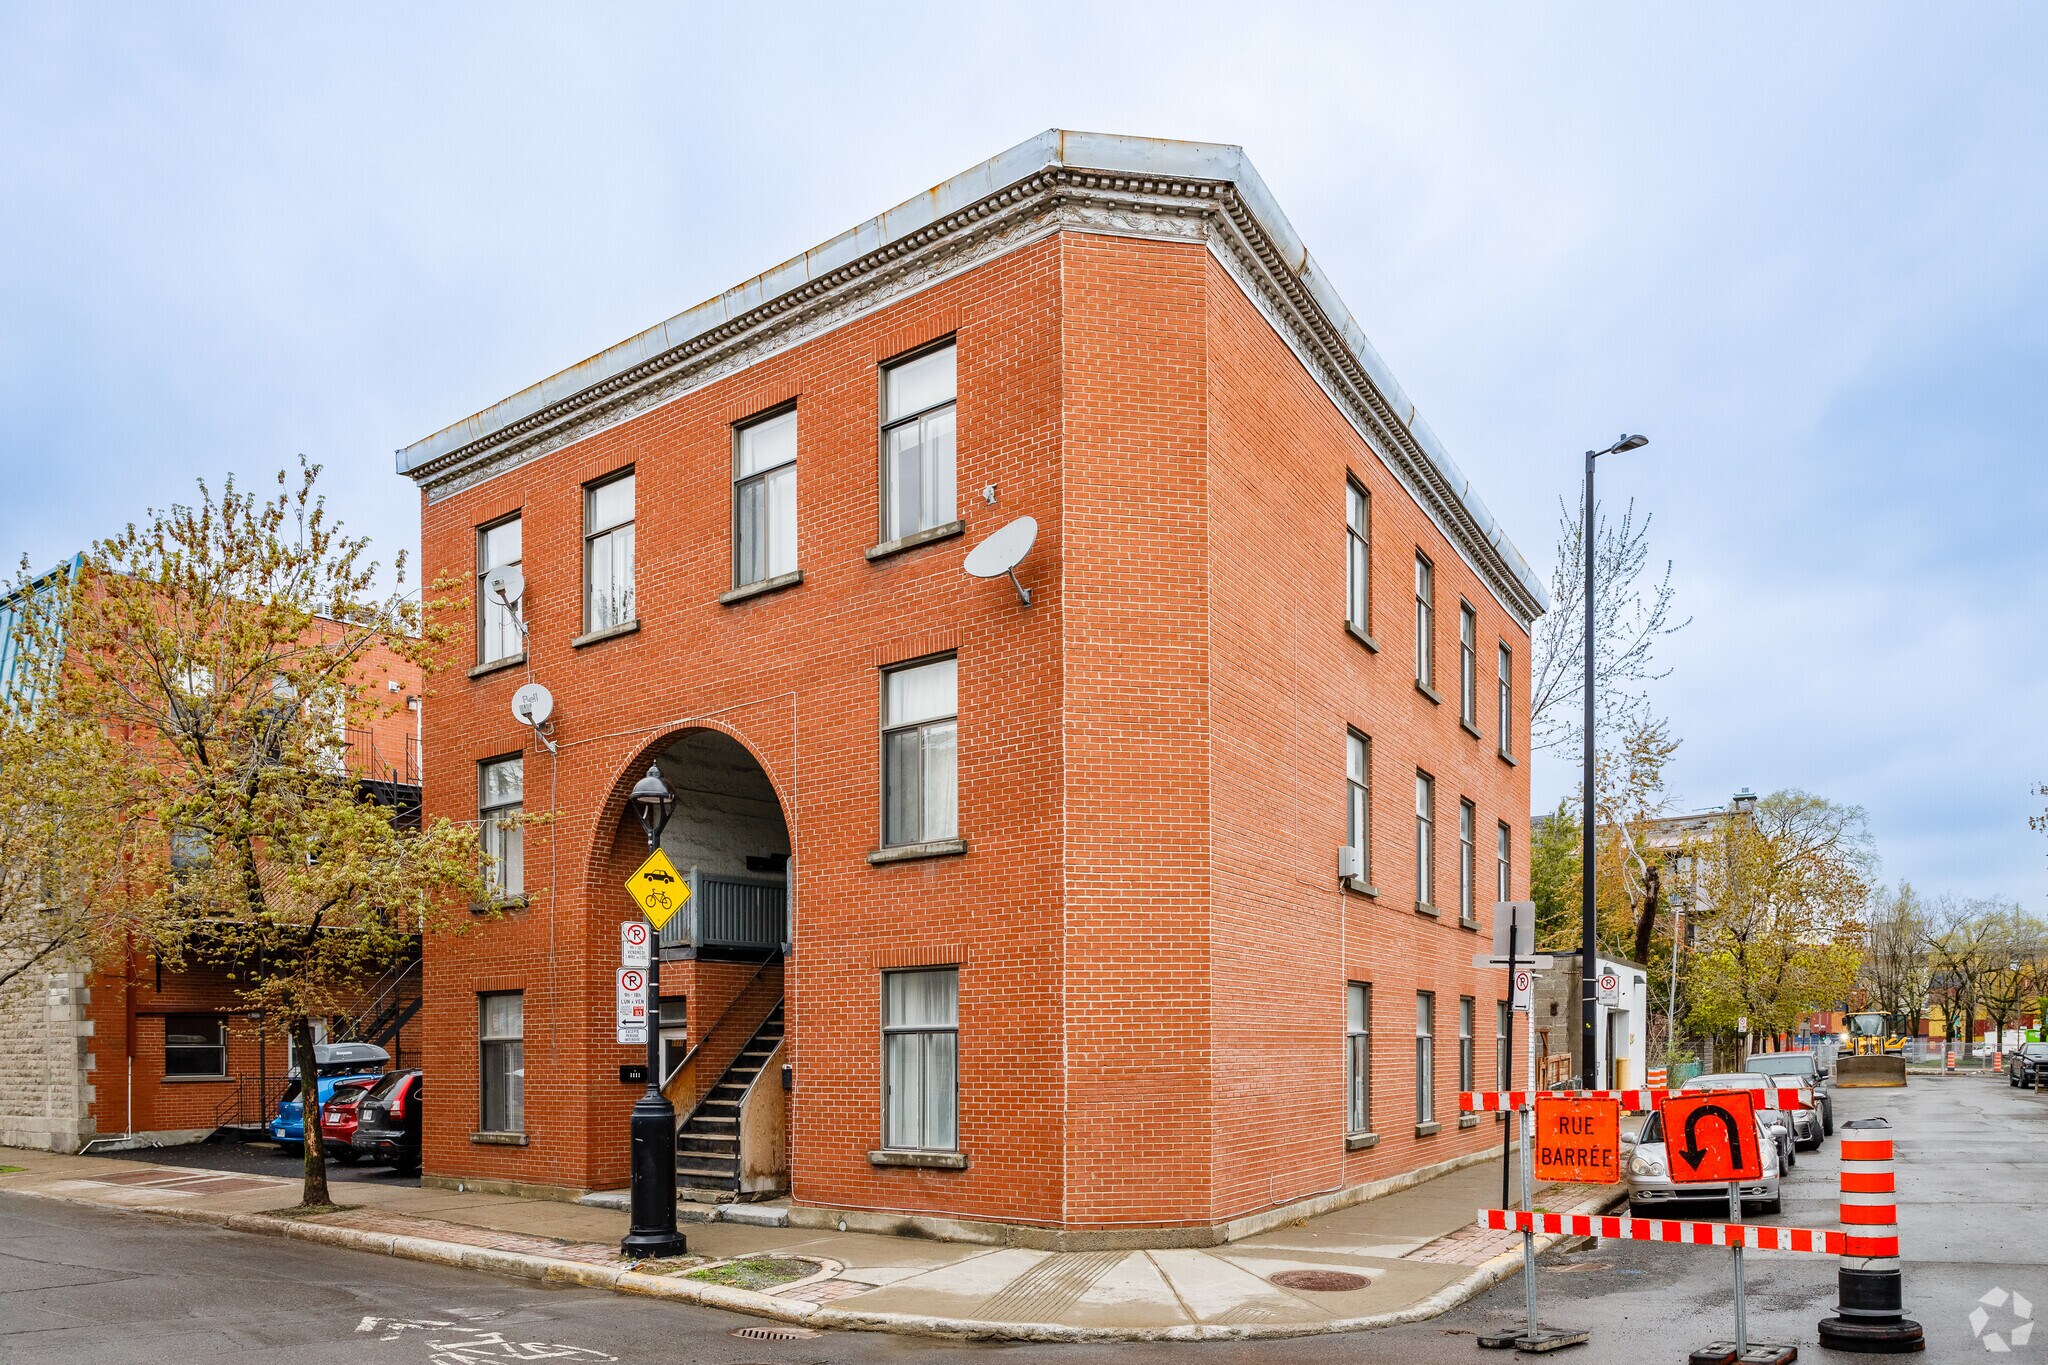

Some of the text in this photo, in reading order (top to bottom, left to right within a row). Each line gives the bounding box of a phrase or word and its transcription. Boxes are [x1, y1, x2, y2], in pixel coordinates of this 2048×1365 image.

[522, 692, 538, 703] Bell
[1559, 1116, 1595, 1135] RUE
[1541, 1145, 1613, 1168] BARRÉE
